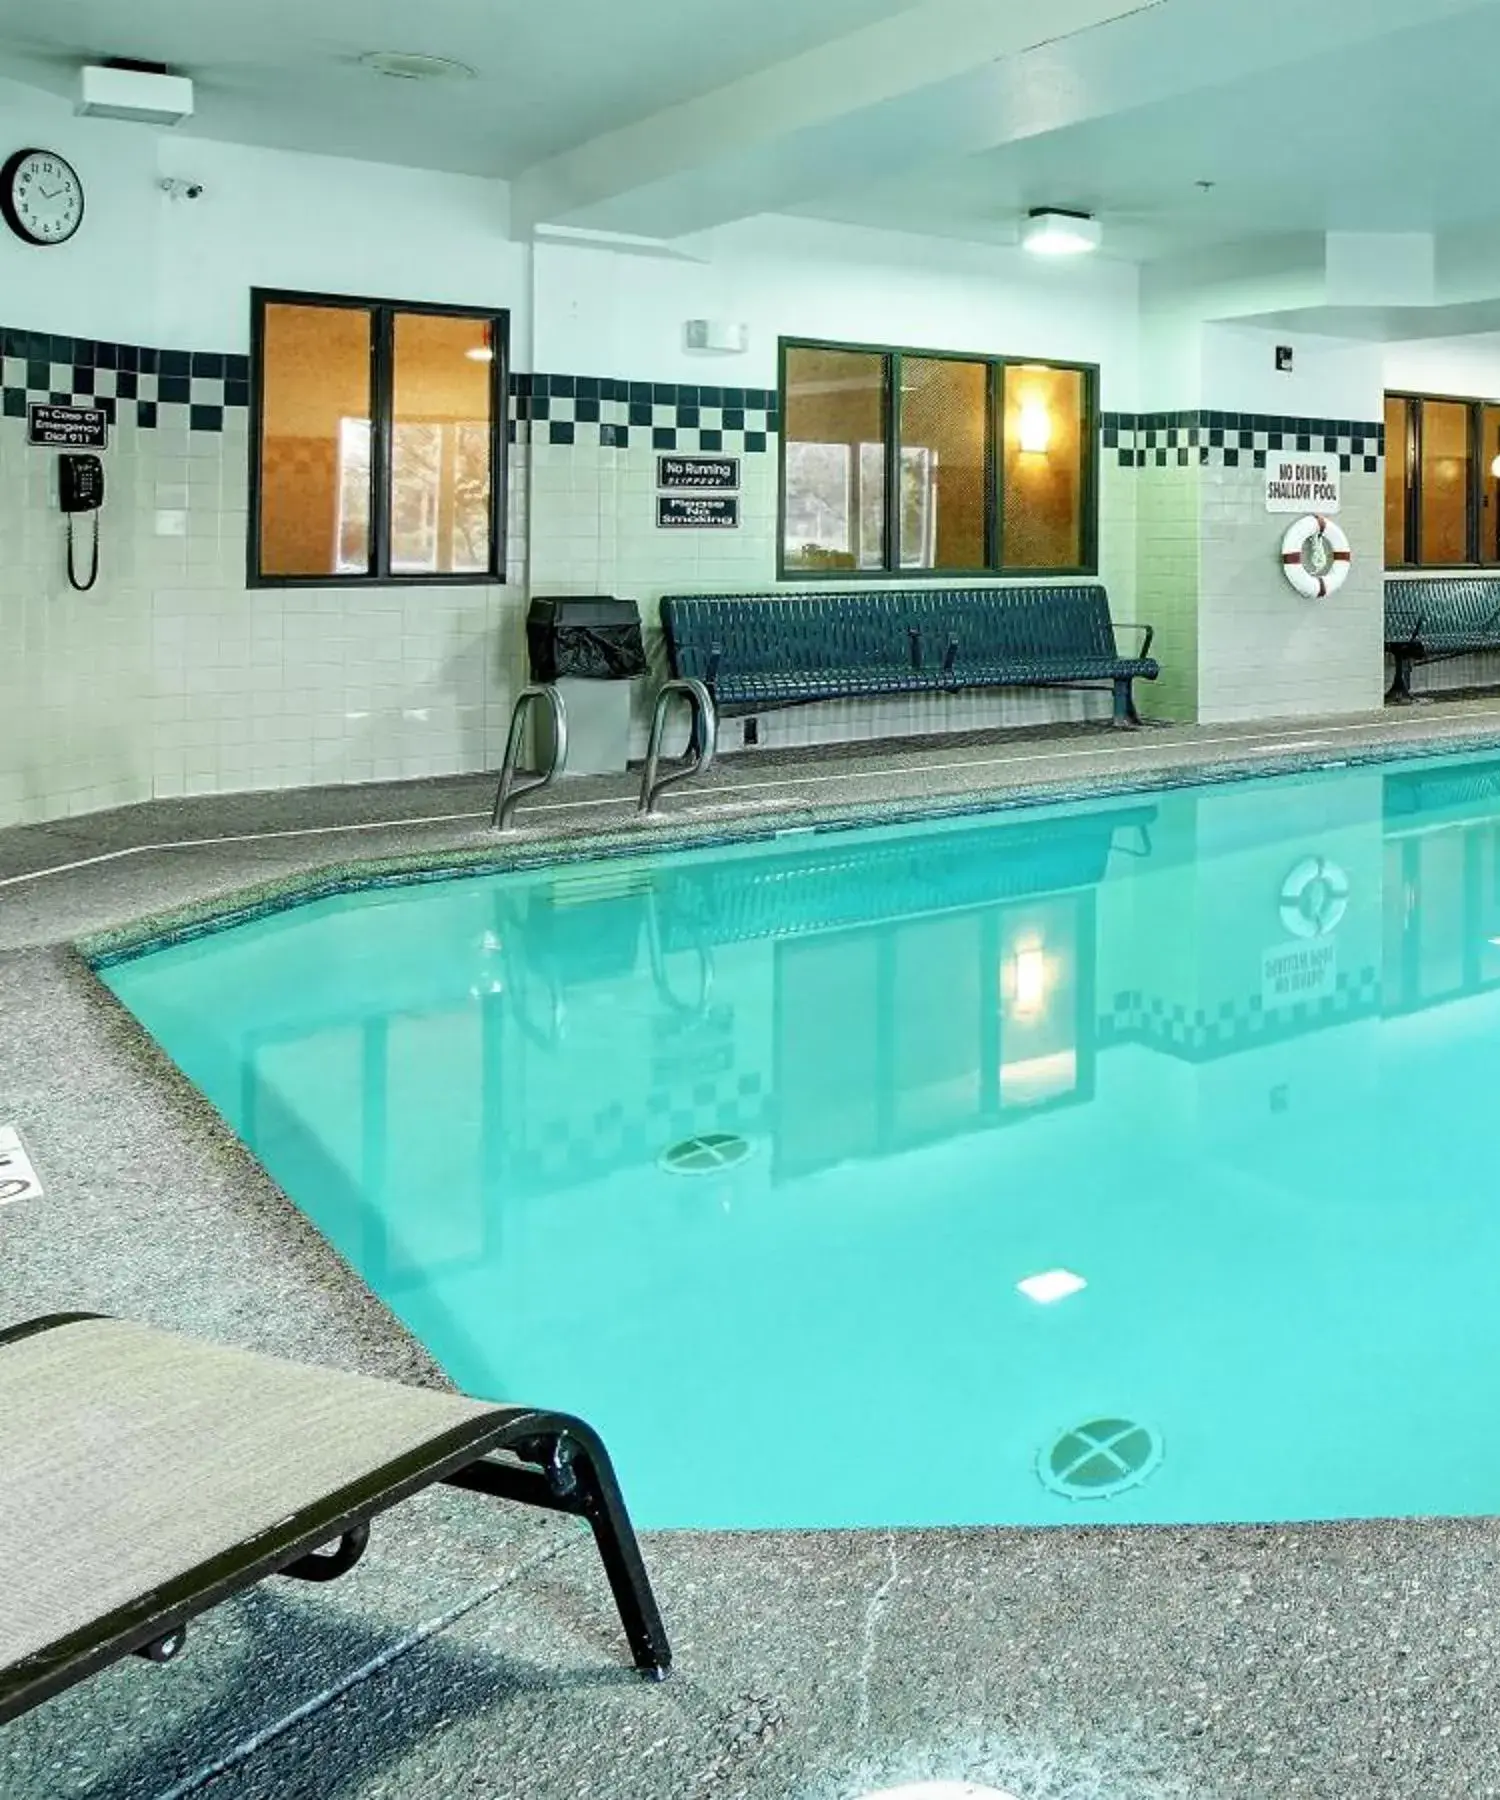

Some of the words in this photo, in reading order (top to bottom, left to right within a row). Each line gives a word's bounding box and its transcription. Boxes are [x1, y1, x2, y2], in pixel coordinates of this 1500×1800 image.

[38, 409, 49, 418] In
[51, 409, 82, 420] Case
[36, 419, 100, 434] Emergency
[44, 431, 67, 441] Dial
[69, 433, 90, 443] 911
[666, 461, 683, 474] No
[685, 462, 731, 478] Running
[1279, 463, 1293, 480] NO
[1295, 464, 1328, 482] DIVING
[1268, 481, 1311, 500] SHALLOW
[1313, 483, 1337, 501] POOL
[670, 499, 725, 508] Please
[685, 507, 710, 515] No
[662, 514, 733, 525] Smoking
